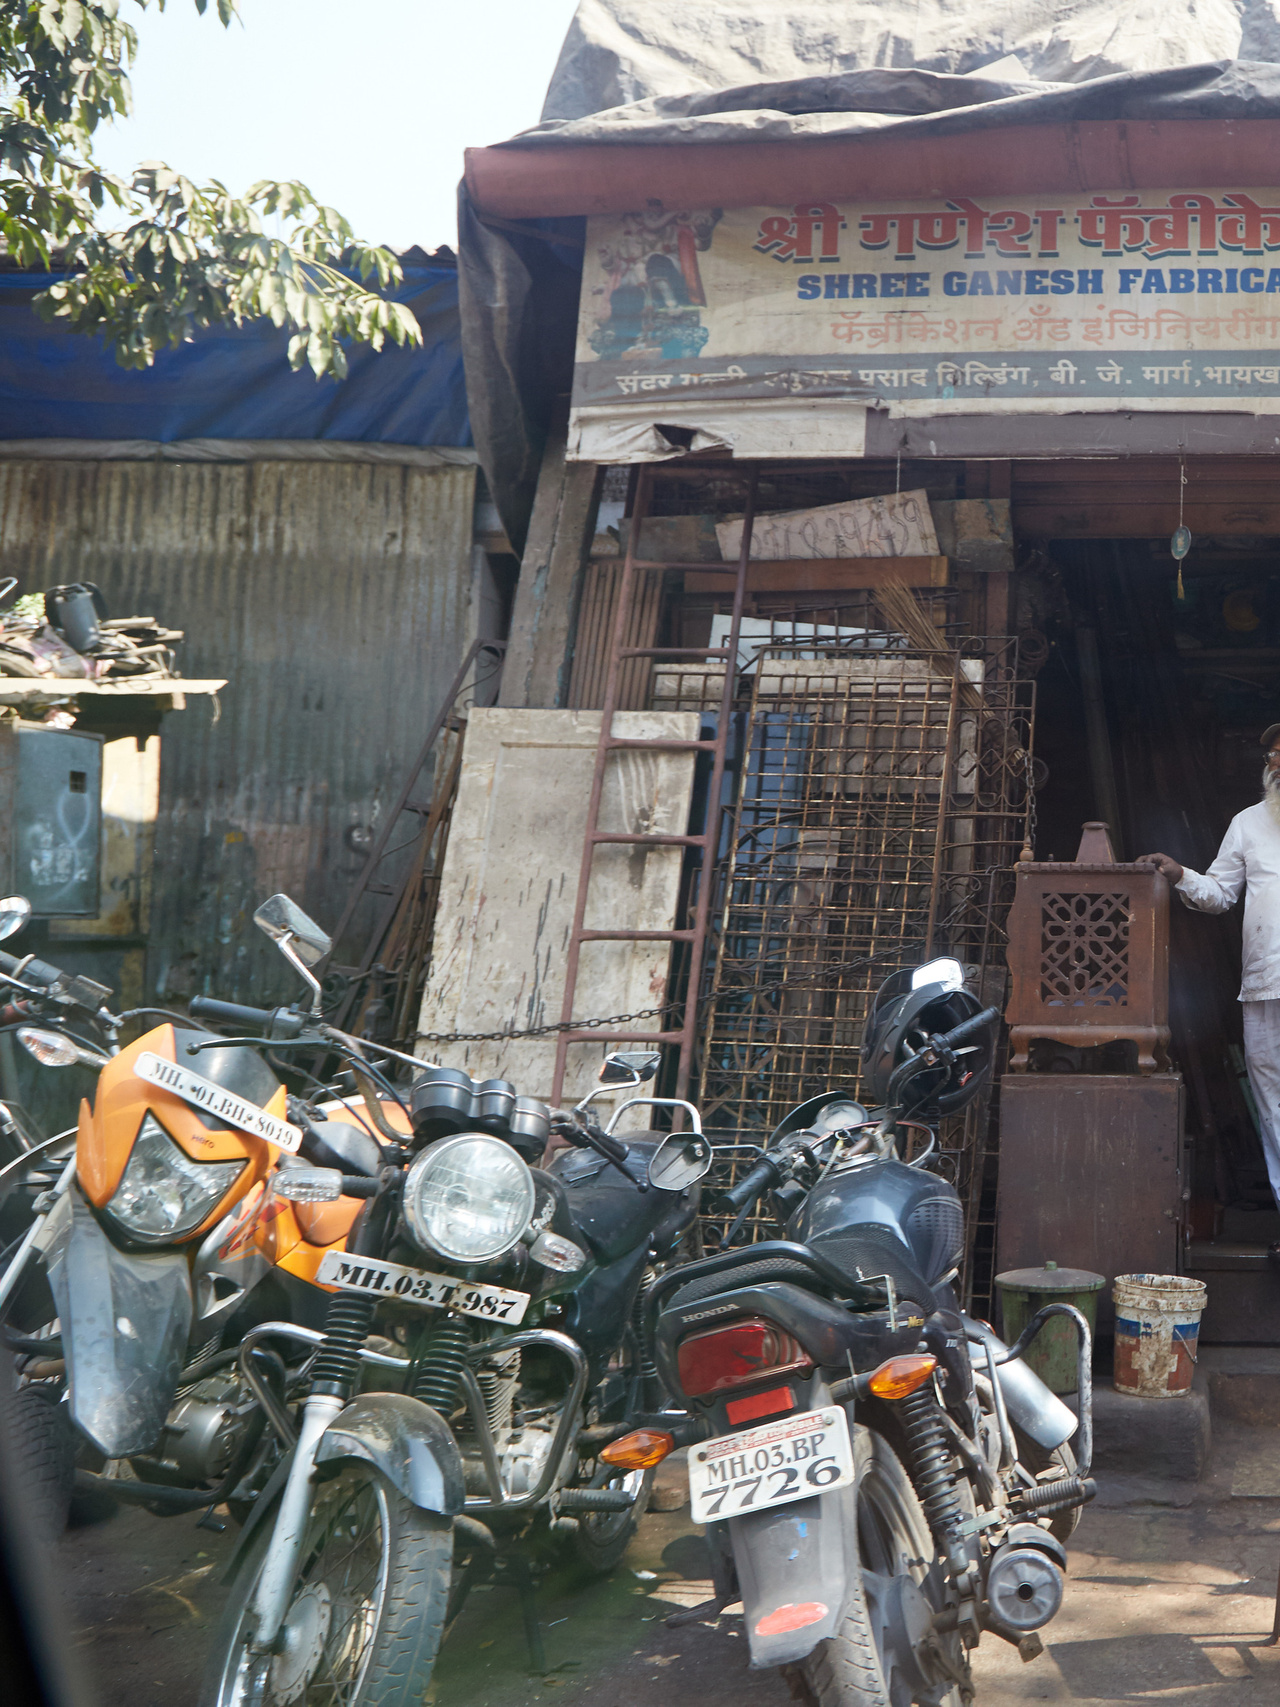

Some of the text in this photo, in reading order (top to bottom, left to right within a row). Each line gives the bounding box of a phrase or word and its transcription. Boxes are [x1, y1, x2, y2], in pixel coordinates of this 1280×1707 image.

[752, 201, 847, 263] श्री
[859, 198, 1066, 261] गणेश
[797, 272, 930, 300] SHREE
[942, 269, 1104, 297] GANESH
[1013, 304, 1072, 342] अँड
[1048, 359, 1086, 385] बी.
[1096, 359, 1132, 385] जे.
[255, 1117, 294, 1146] 8019
[682, 1303, 740, 1323] HONDA
[707, 1433, 825, 1485] MH.03.BP
[701, 1456, 841, 1515] 7726
